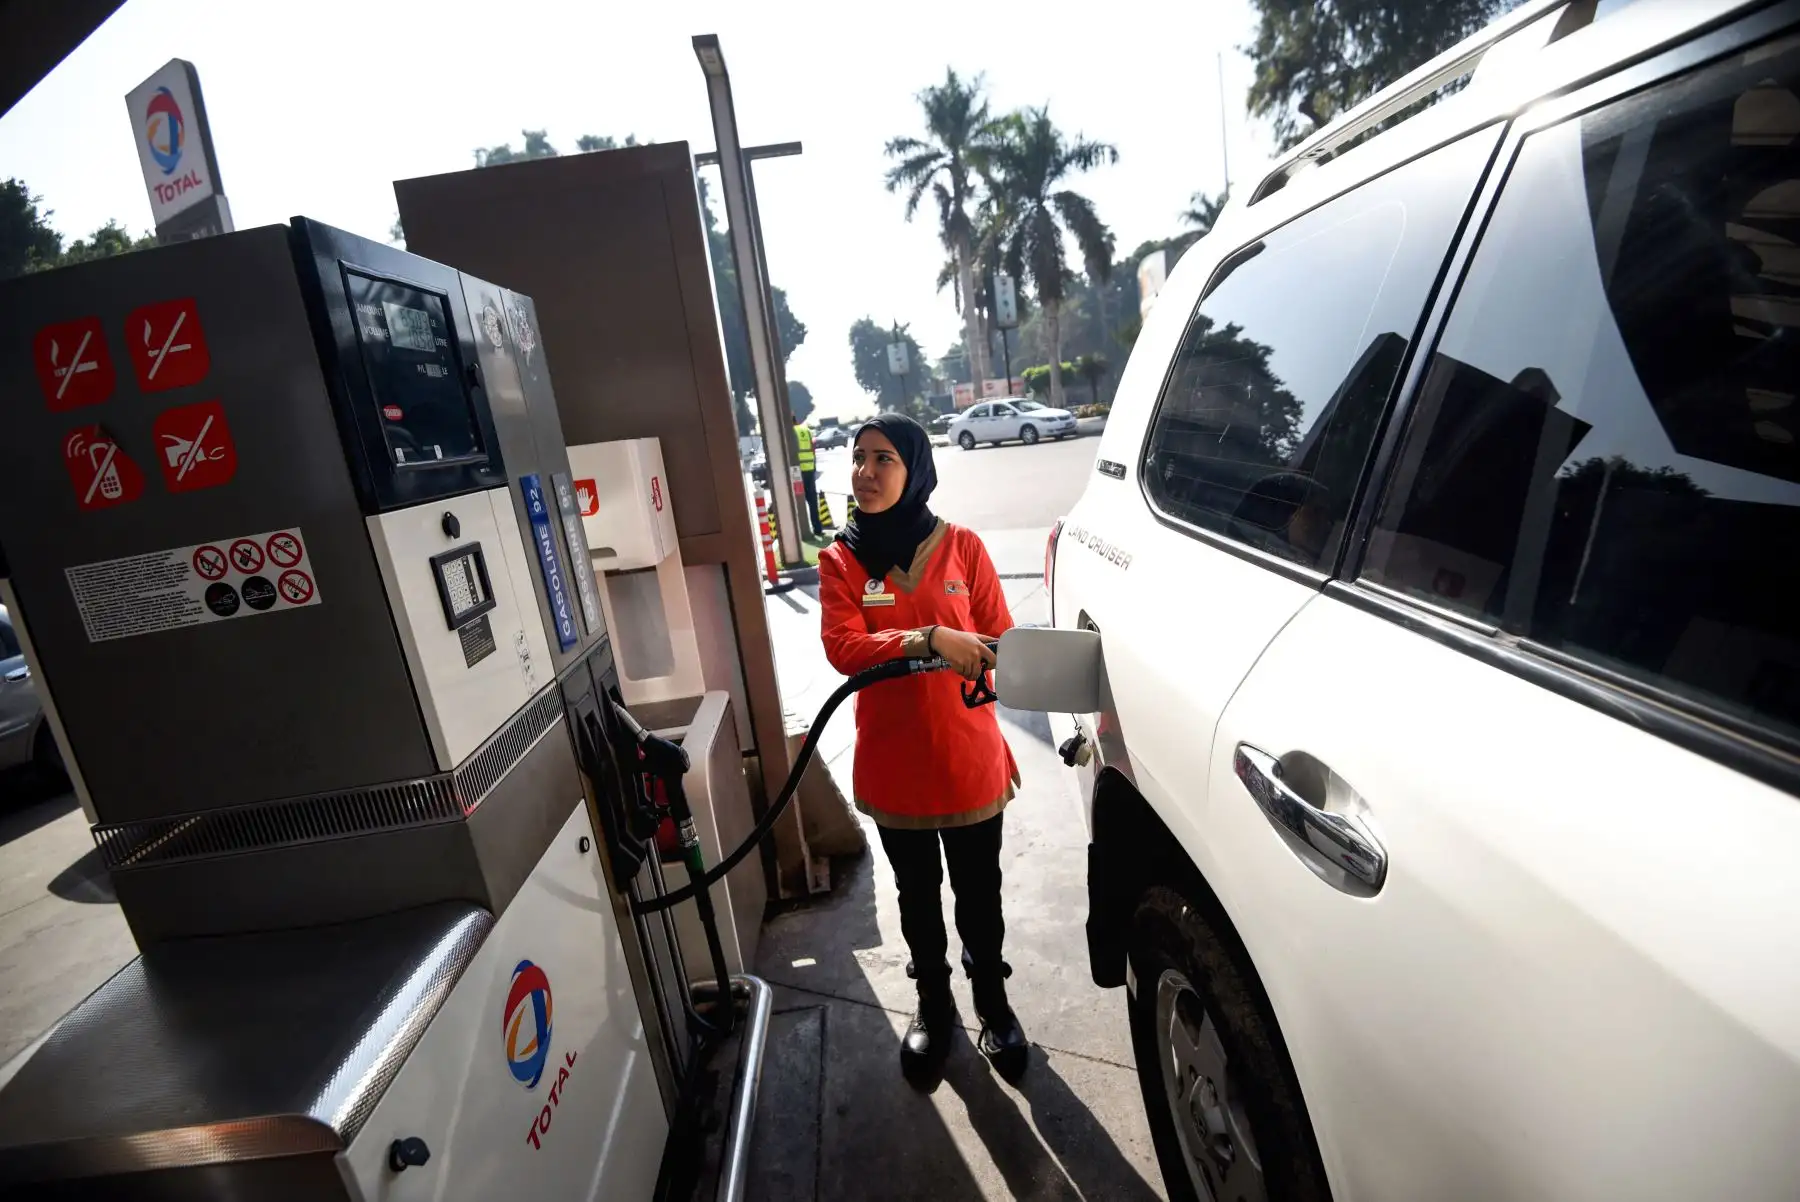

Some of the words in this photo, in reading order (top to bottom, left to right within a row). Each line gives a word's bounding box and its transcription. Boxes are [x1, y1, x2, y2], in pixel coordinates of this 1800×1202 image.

[154, 169, 202, 204] TOTAL
[363, 326, 390, 338] VOLUME
[529, 487, 543, 513] 92
[566, 518, 595, 622] GASOLINE
[1068, 525, 1088, 544] LAND
[1088, 535, 1133, 571] CRUISER
[539, 523, 572, 636] GASOLINE
[527, 1050, 578, 1150] TOTAL
